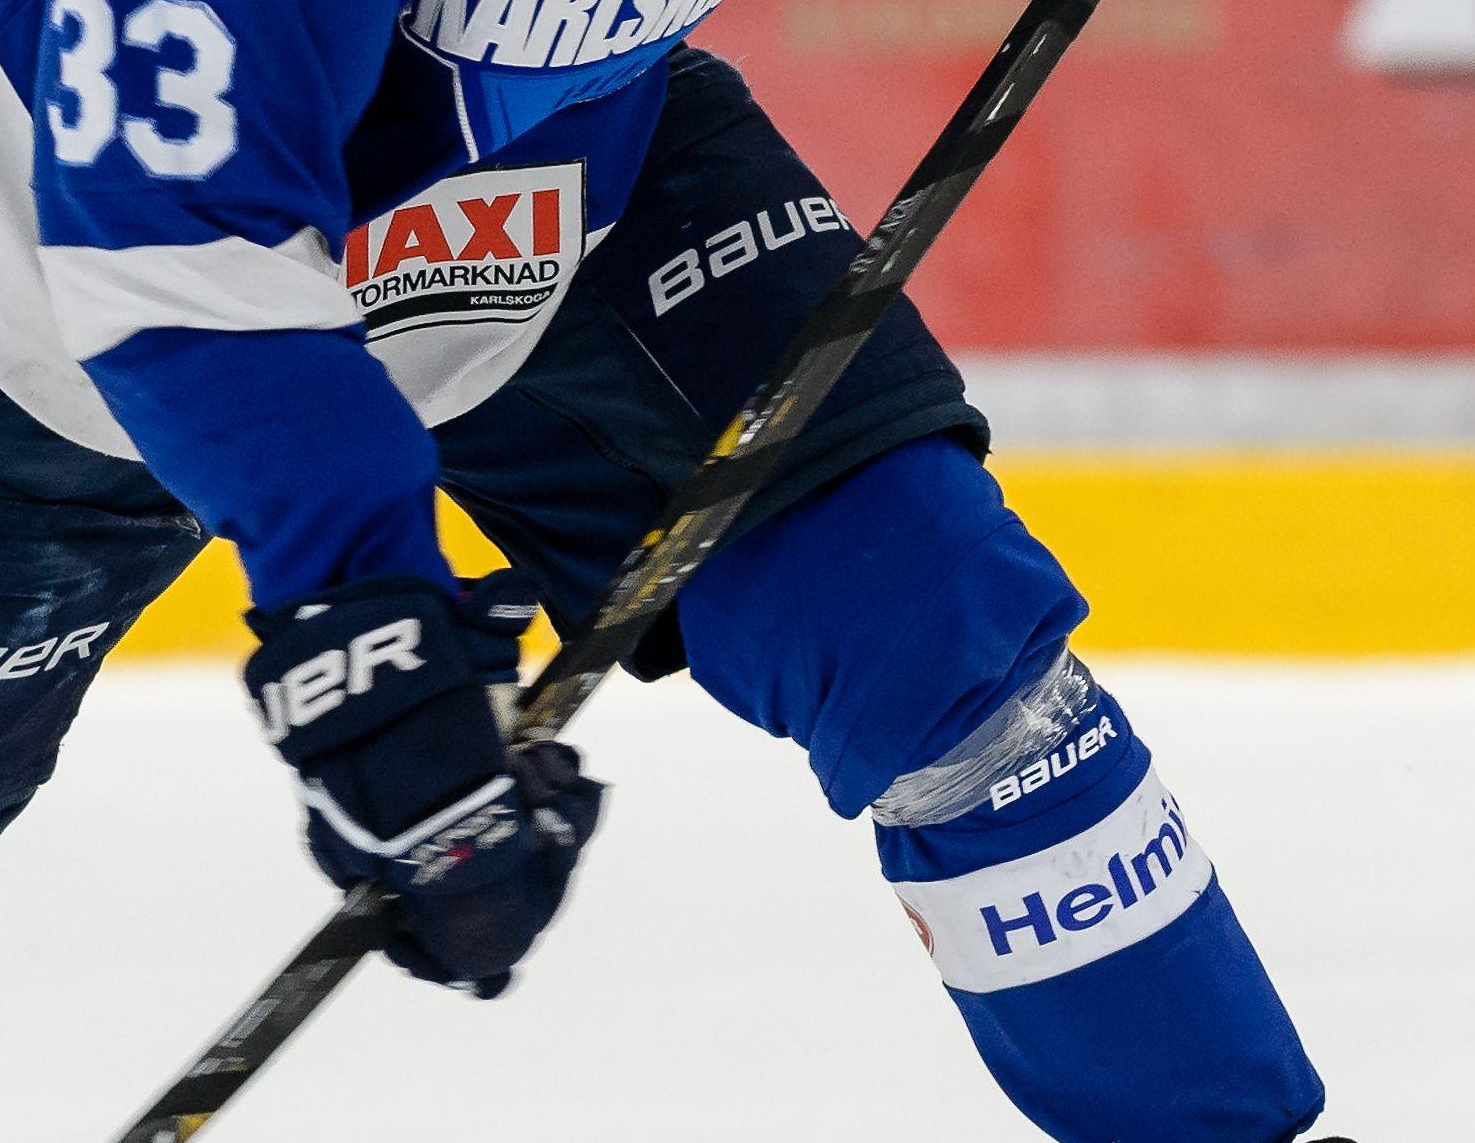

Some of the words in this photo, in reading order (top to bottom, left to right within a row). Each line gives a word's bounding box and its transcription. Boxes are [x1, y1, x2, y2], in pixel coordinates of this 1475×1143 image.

[350, 259, 561, 309] TORMARKNAD
[470, 289, 552, 306] KARLSKOGA
[261, 617, 426, 745] UER
[988, 715, 1119, 812] BAUER
[979, 794, 1189, 957] Helmi
